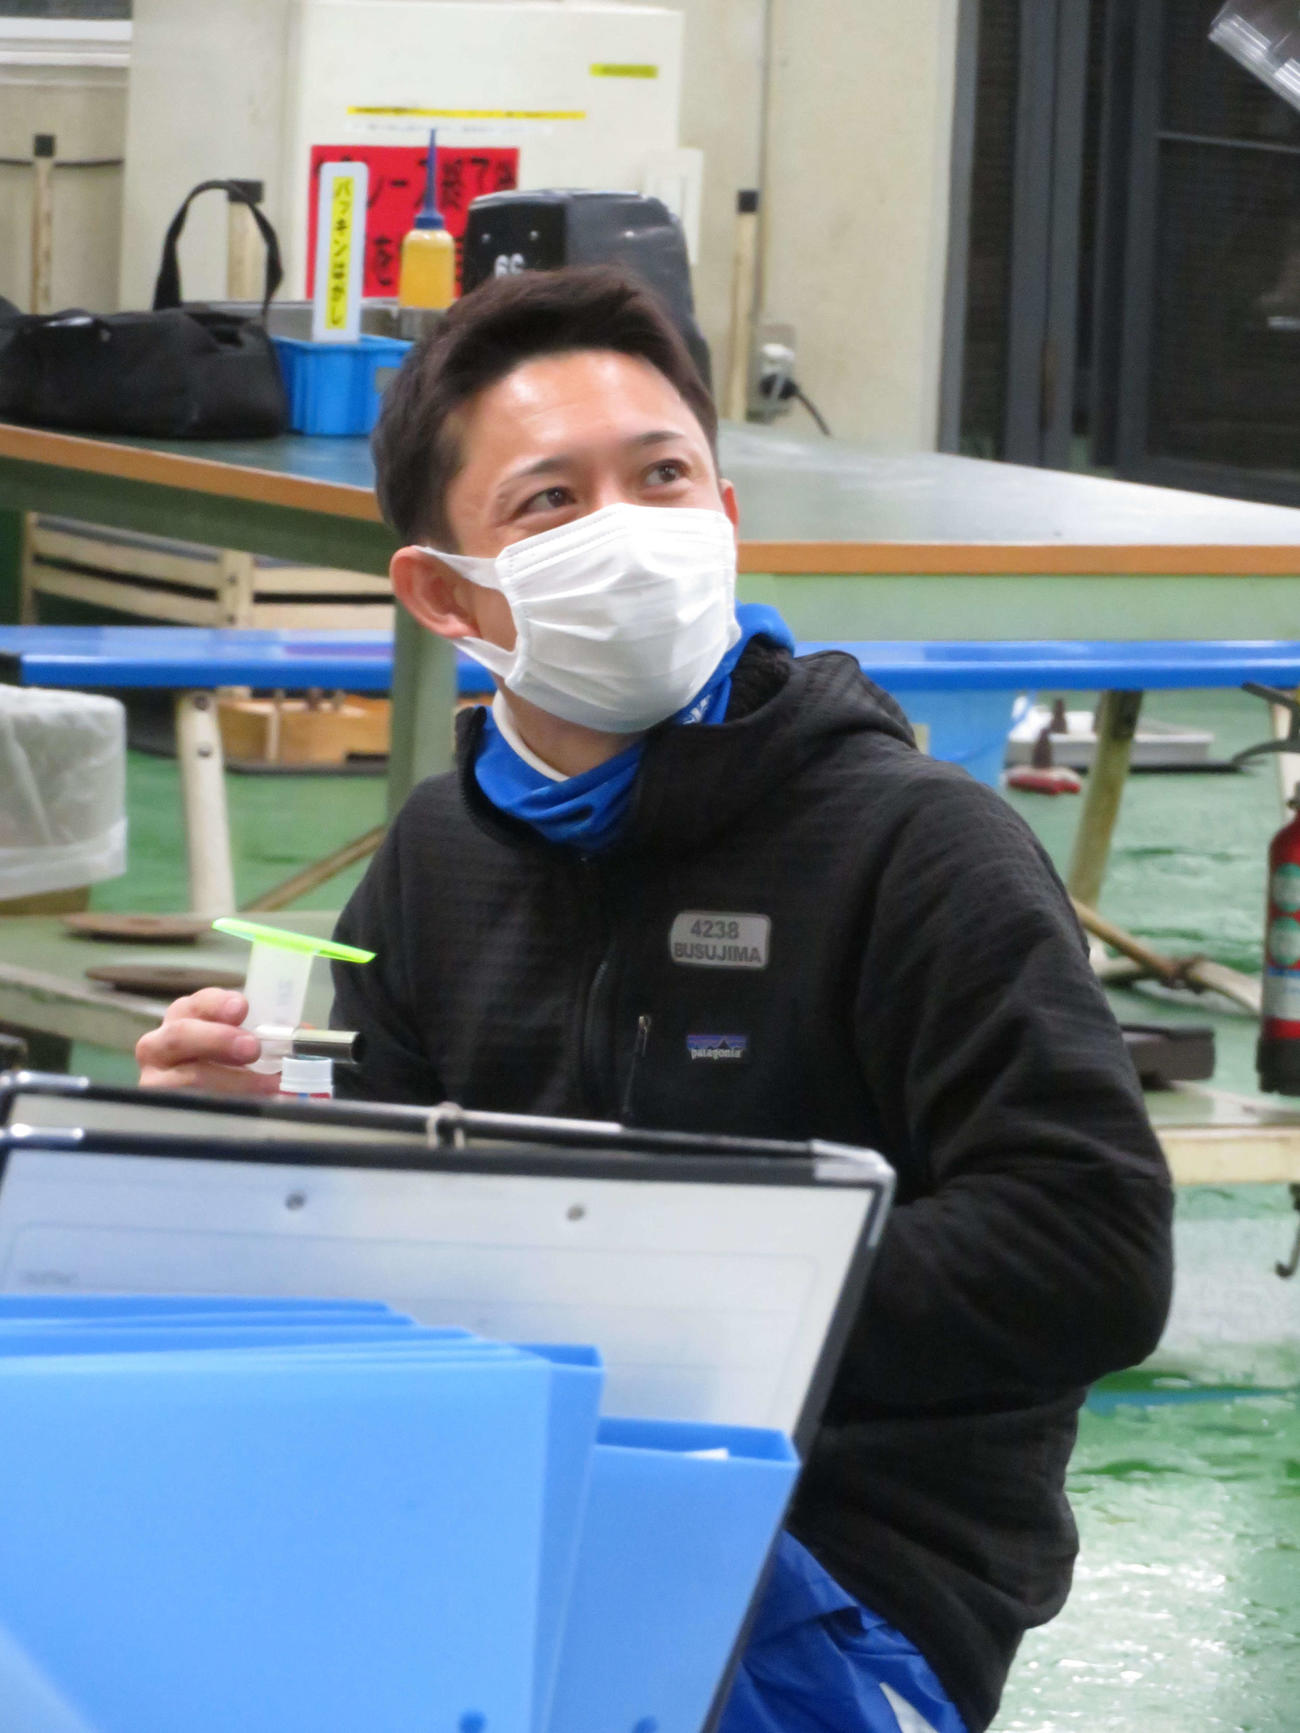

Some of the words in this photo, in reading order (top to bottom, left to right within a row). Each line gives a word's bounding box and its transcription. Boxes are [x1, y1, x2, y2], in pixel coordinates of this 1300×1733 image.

[691, 920, 739, 939] 4238
[674, 943, 761, 962] BUSUJIMA
[691, 1047, 742, 1060] patagonia
